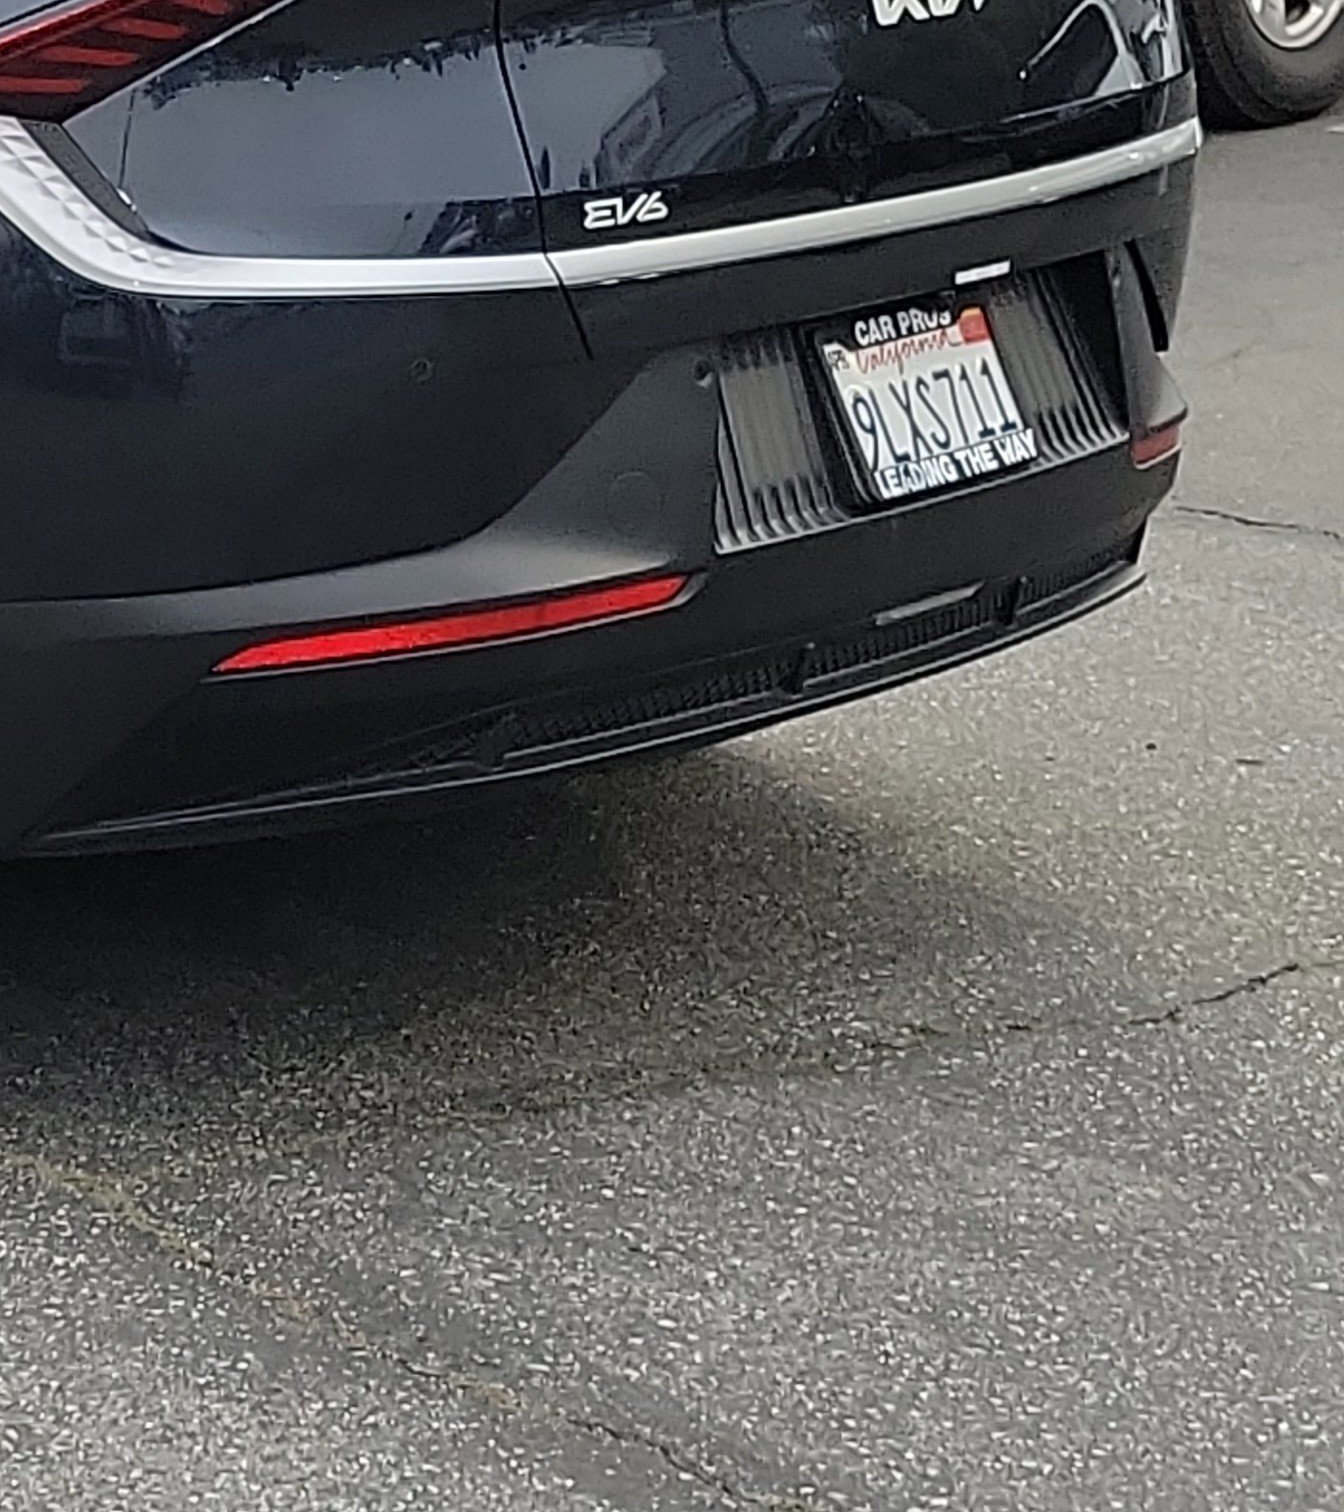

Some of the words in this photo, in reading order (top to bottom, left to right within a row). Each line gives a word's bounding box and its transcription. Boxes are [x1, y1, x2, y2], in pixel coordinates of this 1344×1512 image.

[583, 191, 669, 229] EV6
[854, 315, 897, 346] CAR
[899, 308, 952, 334] PROS
[855, 329, 963, 375] California
[851, 356, 1017, 471] 9LXS711
[874, 459, 952, 499] LEADING
[955, 444, 993, 477] THE
[994, 429, 1038, 464] WAY
